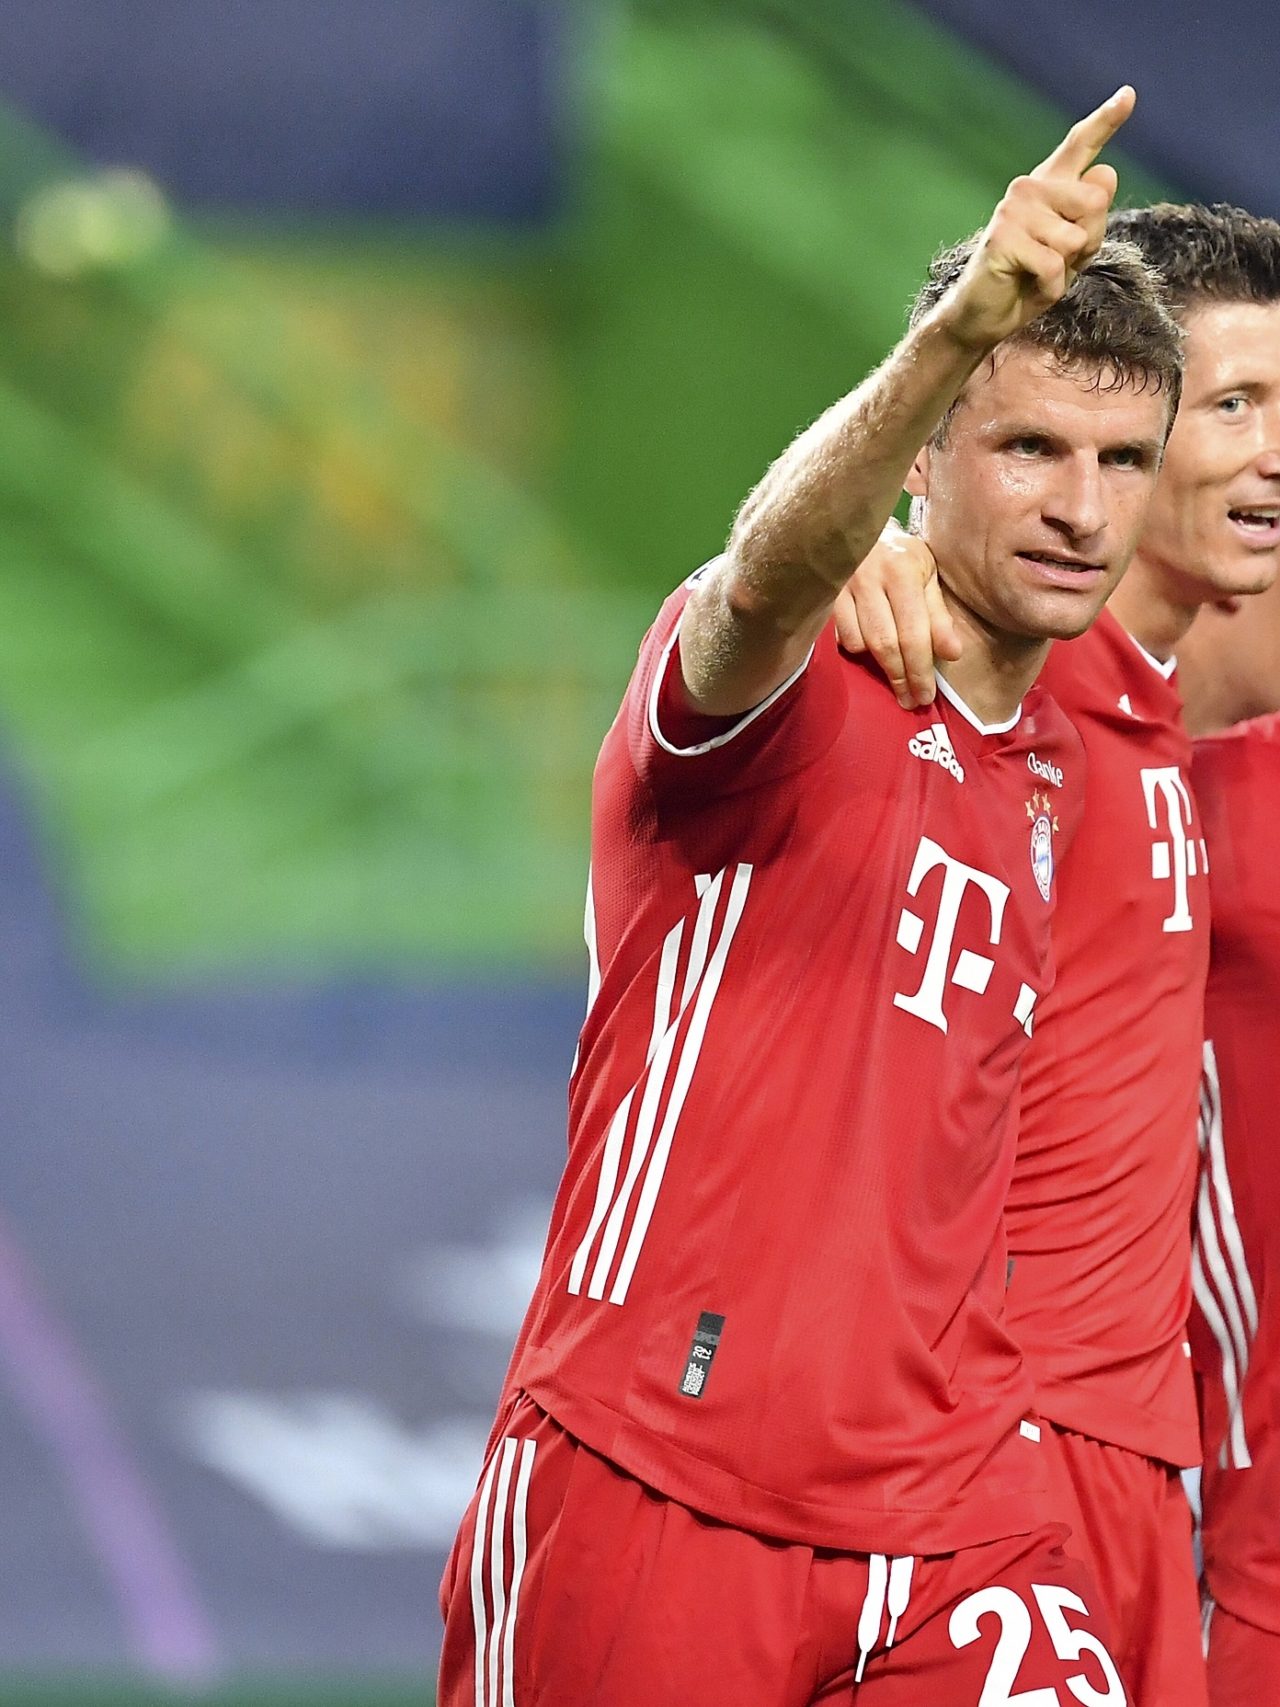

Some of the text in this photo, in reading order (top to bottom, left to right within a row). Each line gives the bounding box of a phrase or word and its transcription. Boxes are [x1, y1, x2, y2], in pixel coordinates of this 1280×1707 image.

[908, 737, 965, 784] adidas
[1027, 752, 1064, 788] Danke
[893, 835, 1011, 1035] T
[948, 1583, 1128, 1707] 25
